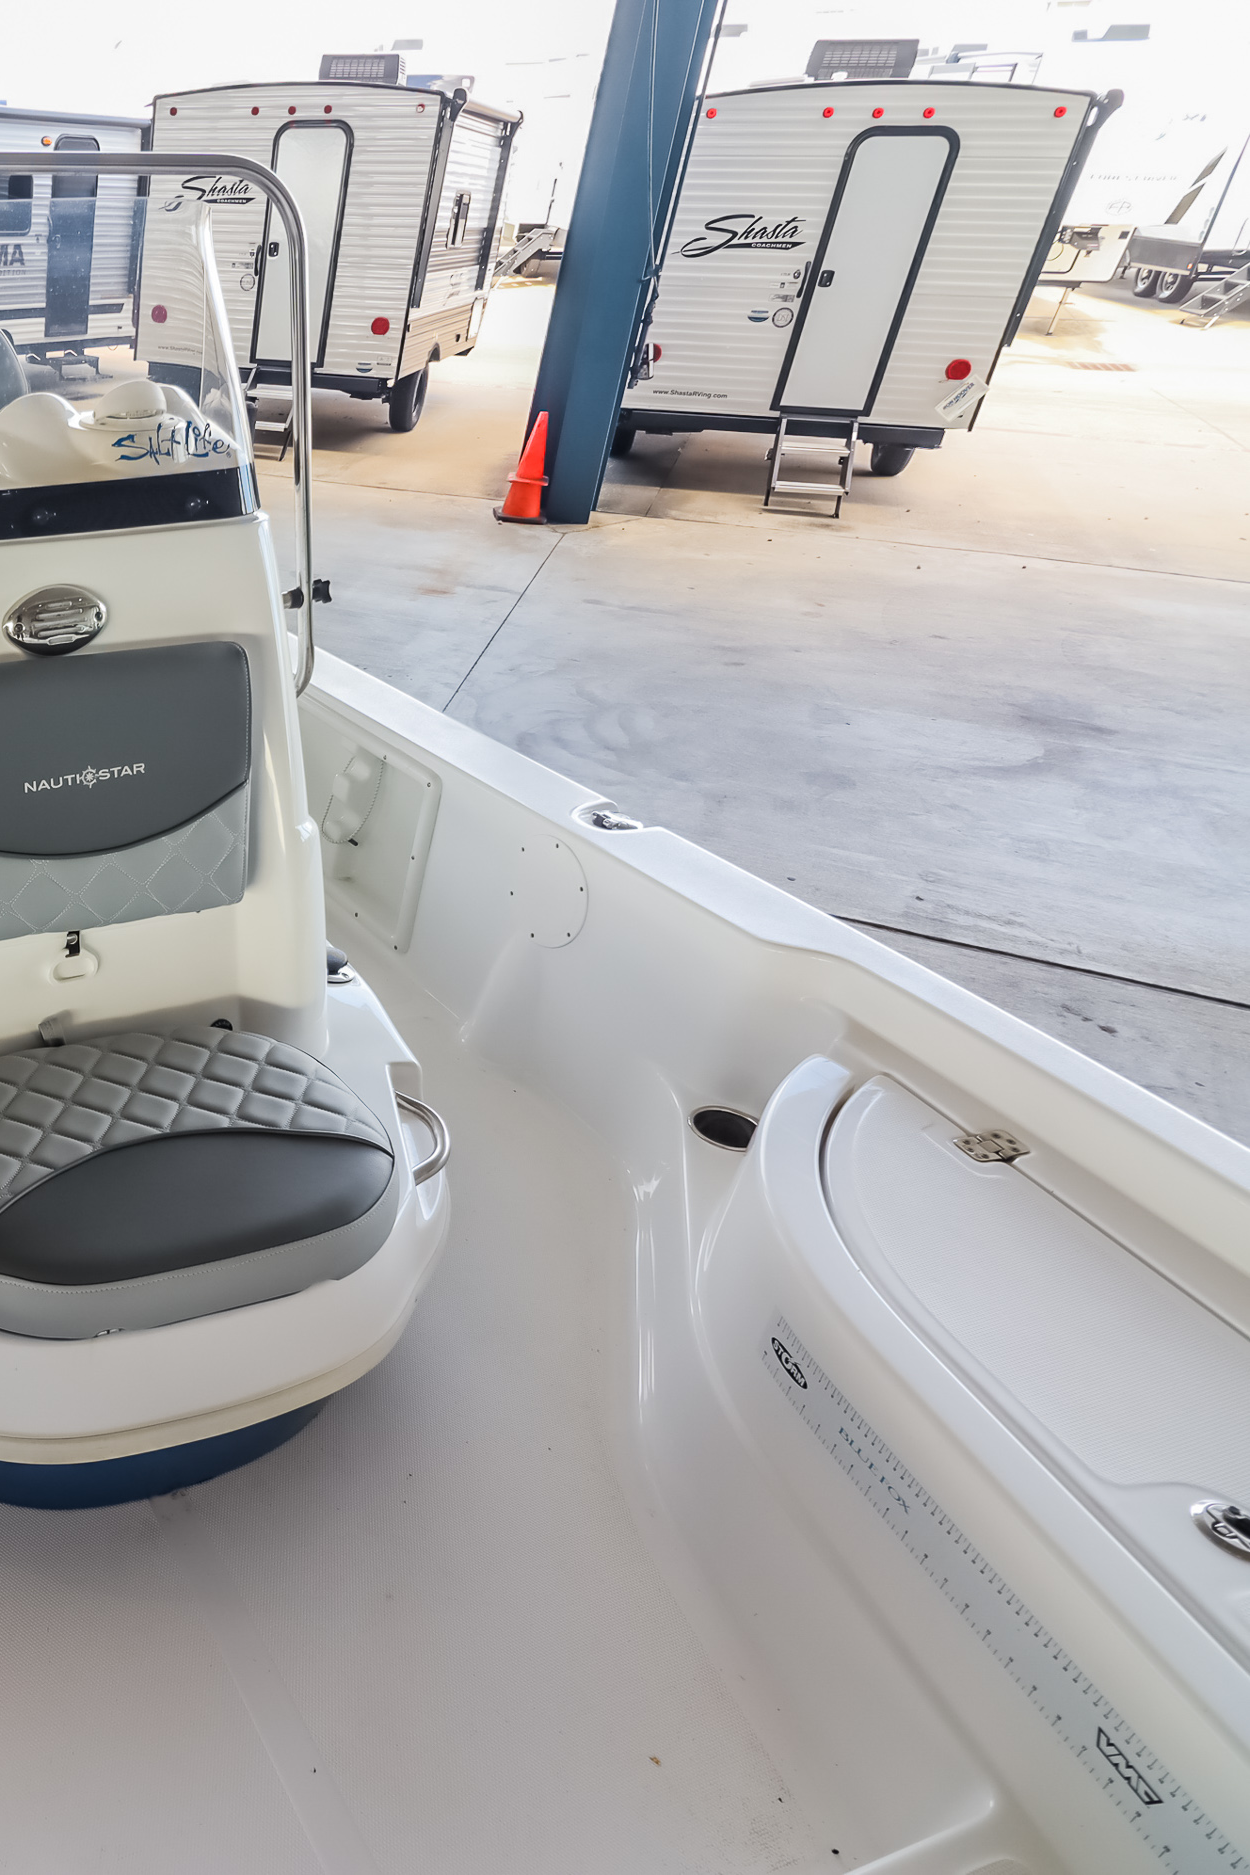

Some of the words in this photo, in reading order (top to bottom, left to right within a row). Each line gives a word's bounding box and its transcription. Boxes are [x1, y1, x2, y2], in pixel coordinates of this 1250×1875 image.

[671, 213, 807, 258] Shasta
[750, 242, 793, 250] COACHMEN
[652, 389, 728, 399] www.ShastaRVing.com
[771, 1337, 807, 1389] STORM
[838, 1426, 878, 1477] BLUE
[879, 1476, 910, 1515] FOX
[1095, 1726, 1164, 1806] VMC
